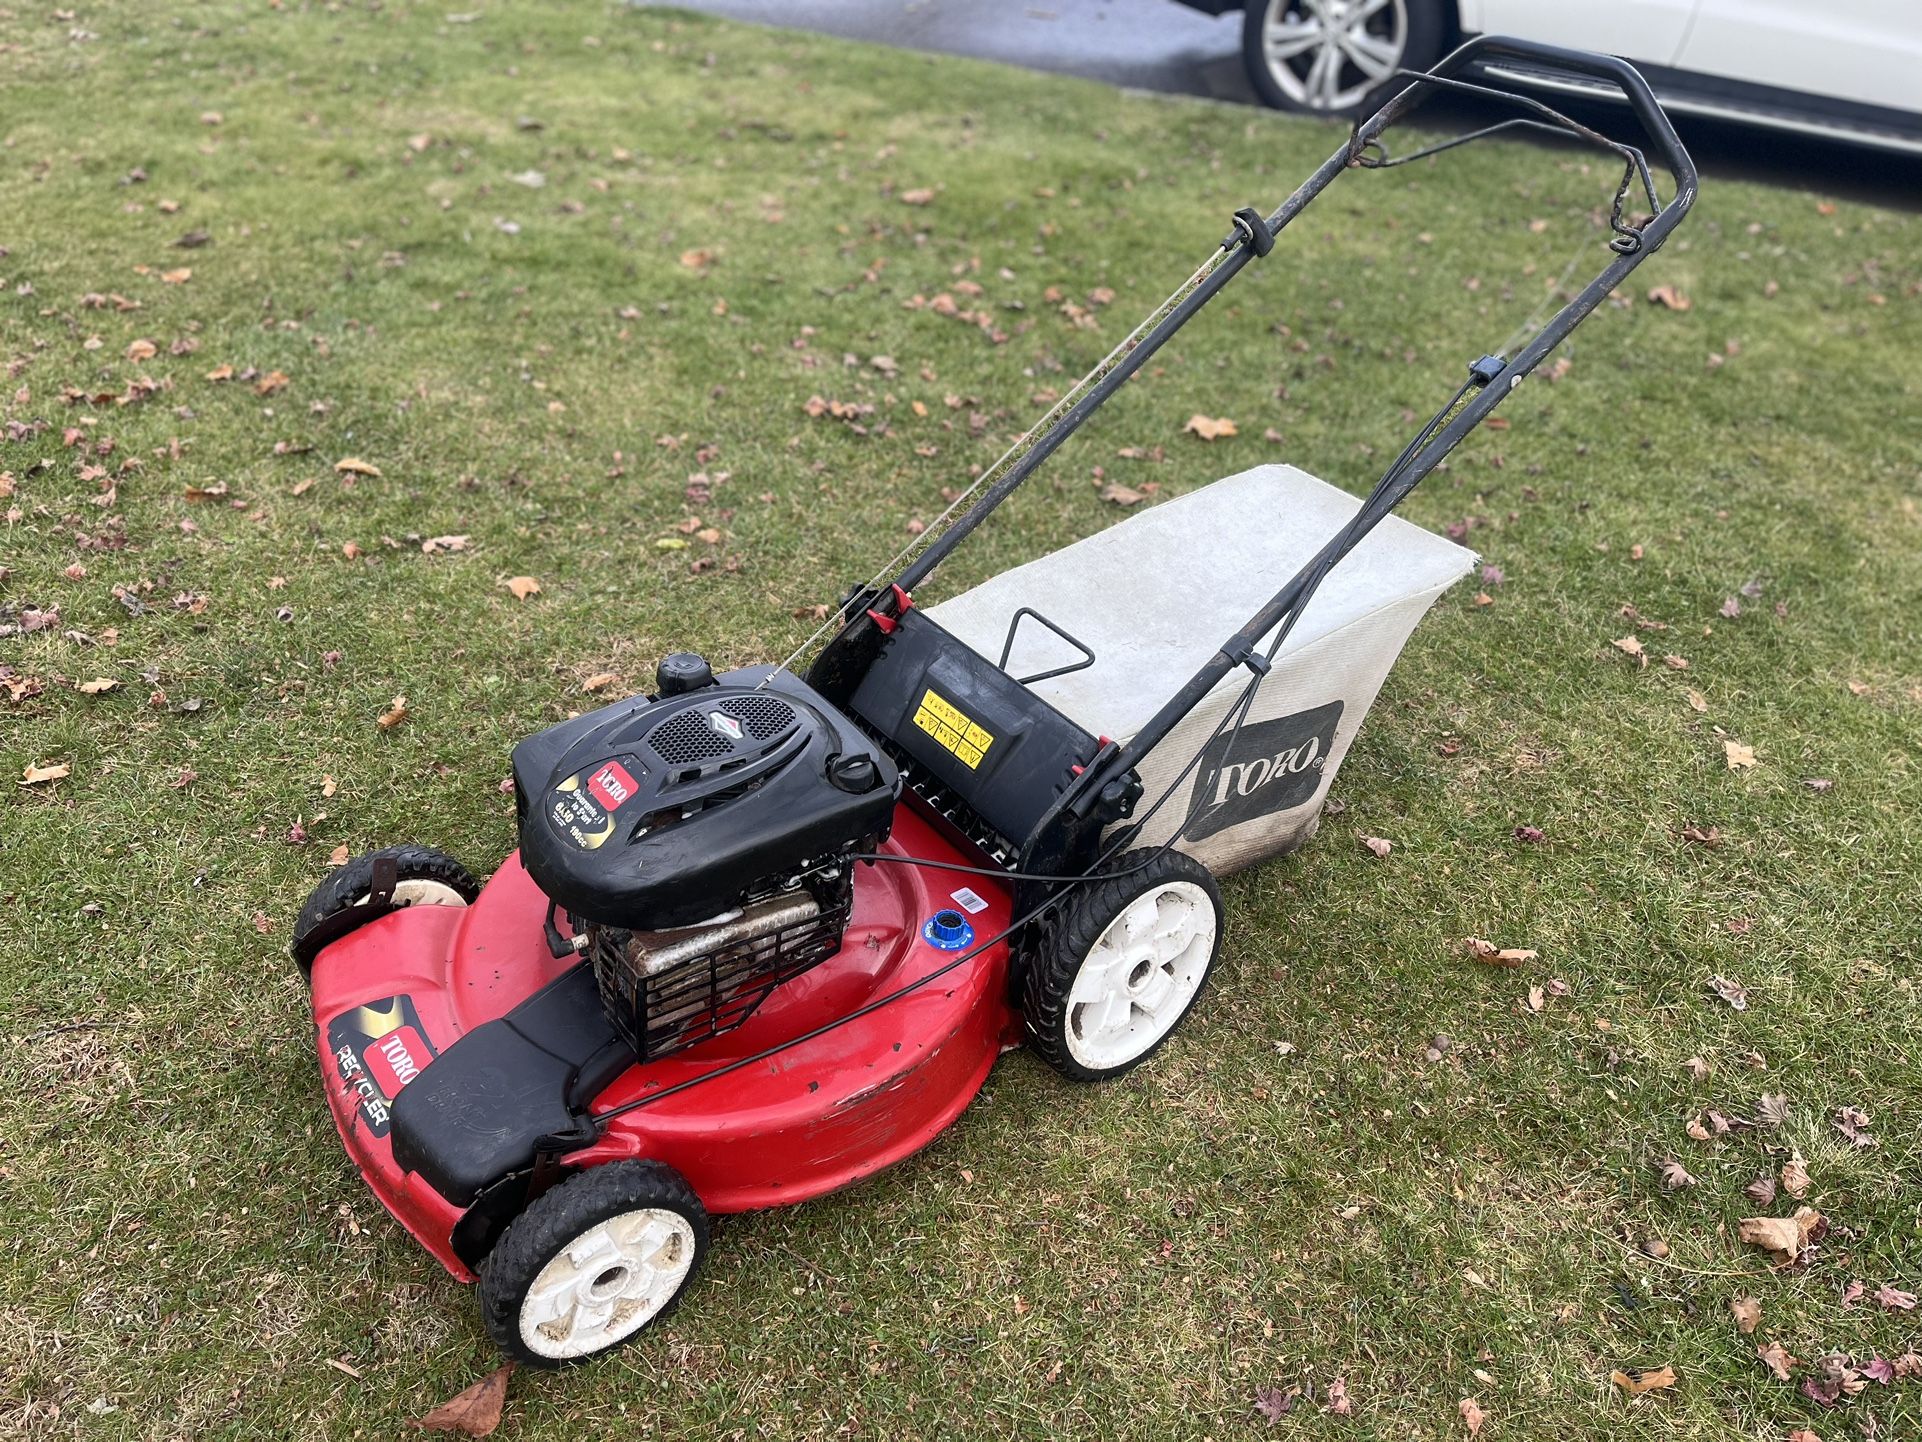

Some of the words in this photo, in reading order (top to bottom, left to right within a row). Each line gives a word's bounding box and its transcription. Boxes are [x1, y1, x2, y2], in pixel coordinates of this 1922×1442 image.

[596, 769, 628, 803] TORO
[1206, 736, 1320, 807] TORO
[573, 788, 606, 825] Guarante
[569, 825, 588, 848] 190cc
[380, 1035, 421, 1085] TORO
